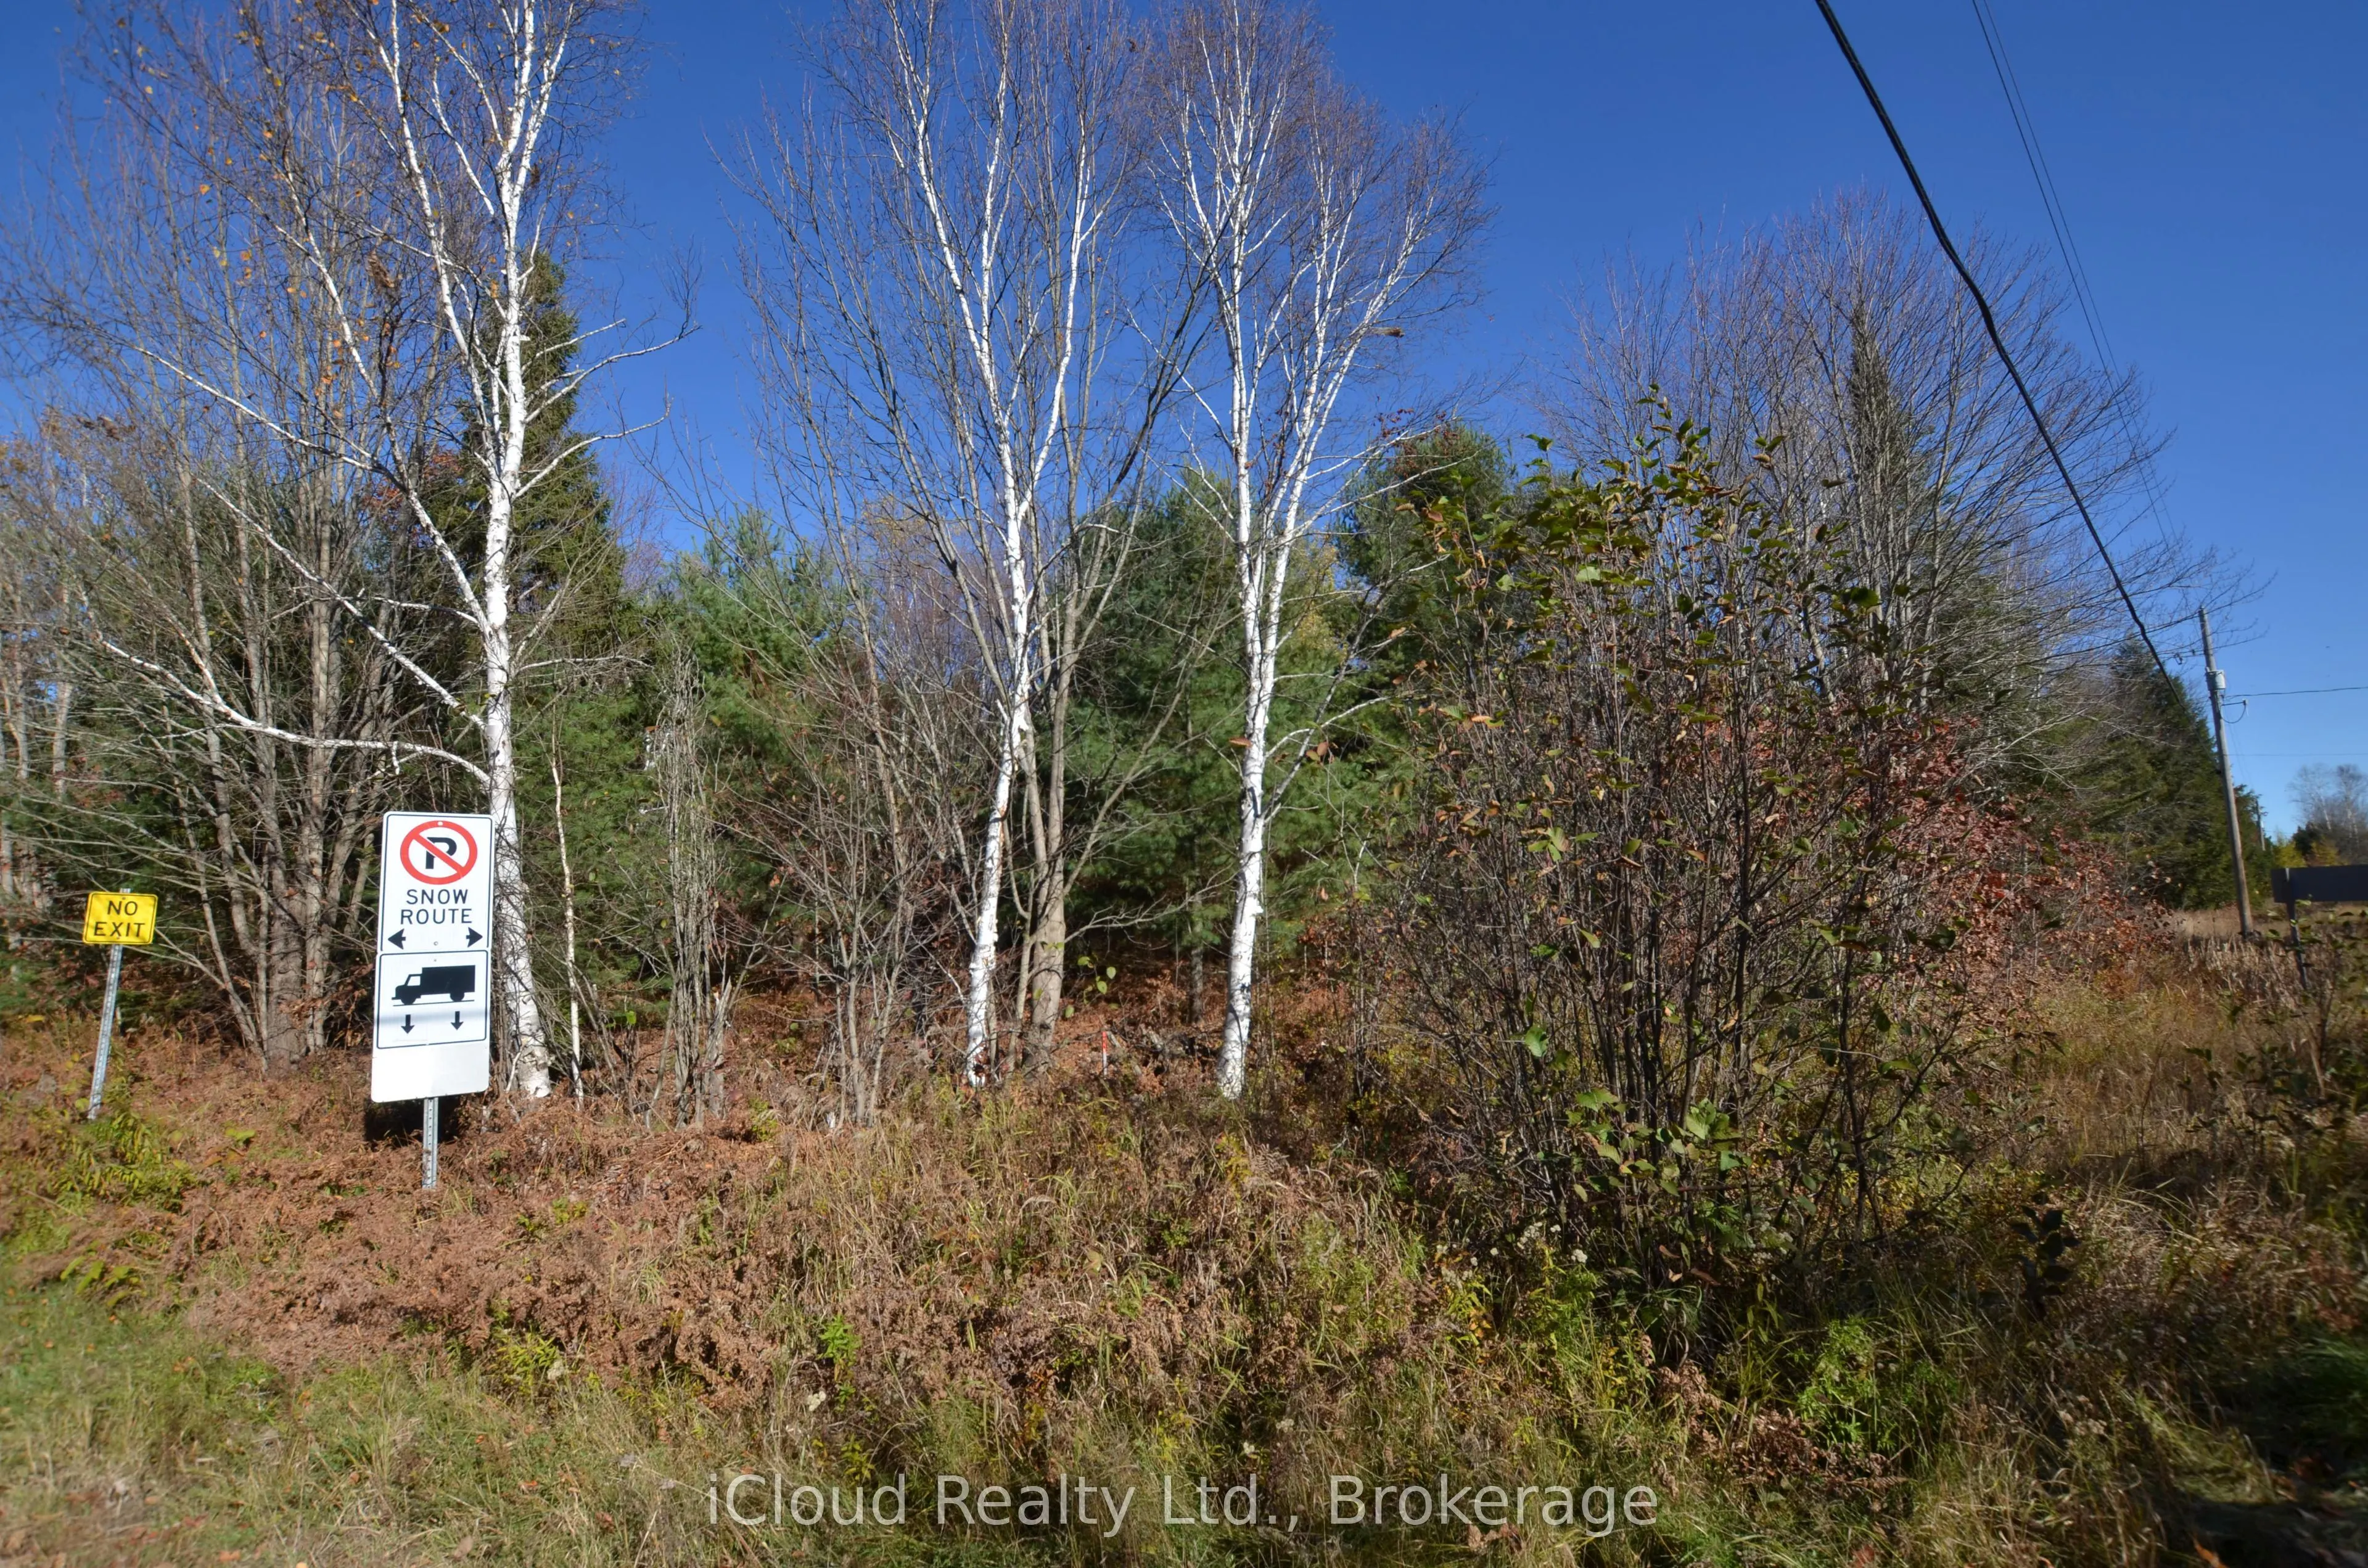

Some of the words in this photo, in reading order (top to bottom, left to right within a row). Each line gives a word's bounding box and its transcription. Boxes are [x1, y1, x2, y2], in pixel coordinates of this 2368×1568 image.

[426, 837, 457, 869] P
[406, 889, 468, 905] SNOW
[107, 900, 138, 916] NO
[401, 908, 472, 925] ROUTE
[94, 921, 146, 937] EXIT
